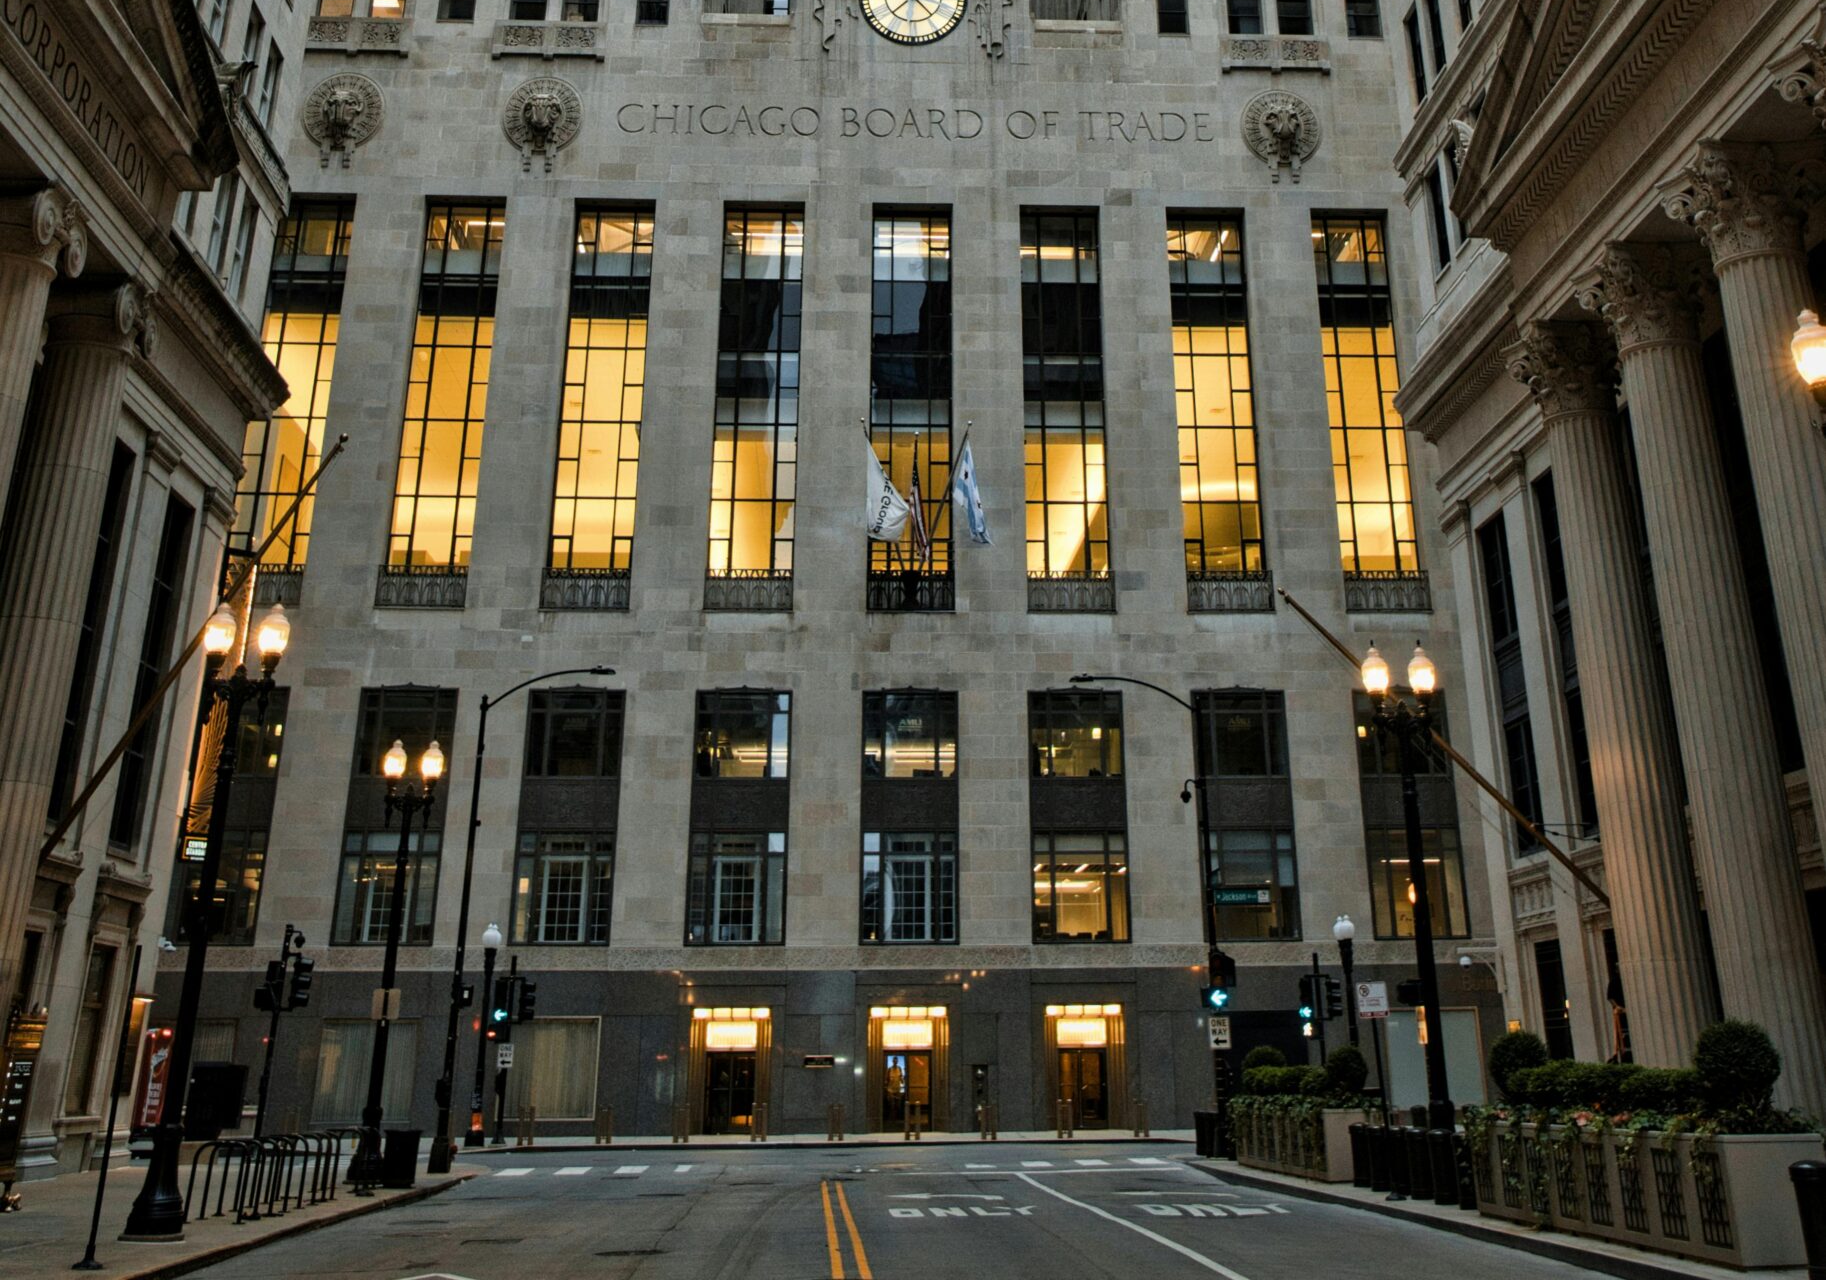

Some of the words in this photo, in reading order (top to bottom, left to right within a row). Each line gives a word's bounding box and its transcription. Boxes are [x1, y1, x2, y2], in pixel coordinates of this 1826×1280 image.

[617, 103, 821, 137] CHICAGO
[840, 107, 983, 141] BOARD
[1006, 110, 1059, 141] OF
[1079, 110, 1214, 143] TRADE
[1221, 891, 1247, 902] Jackson
[1210, 1018, 1227, 1028] ONE
[1211, 1028, 1227, 1037] WAY
[888, 1205, 1038, 1218] ONLY
[1133, 1203, 1292, 1217] ONLY
